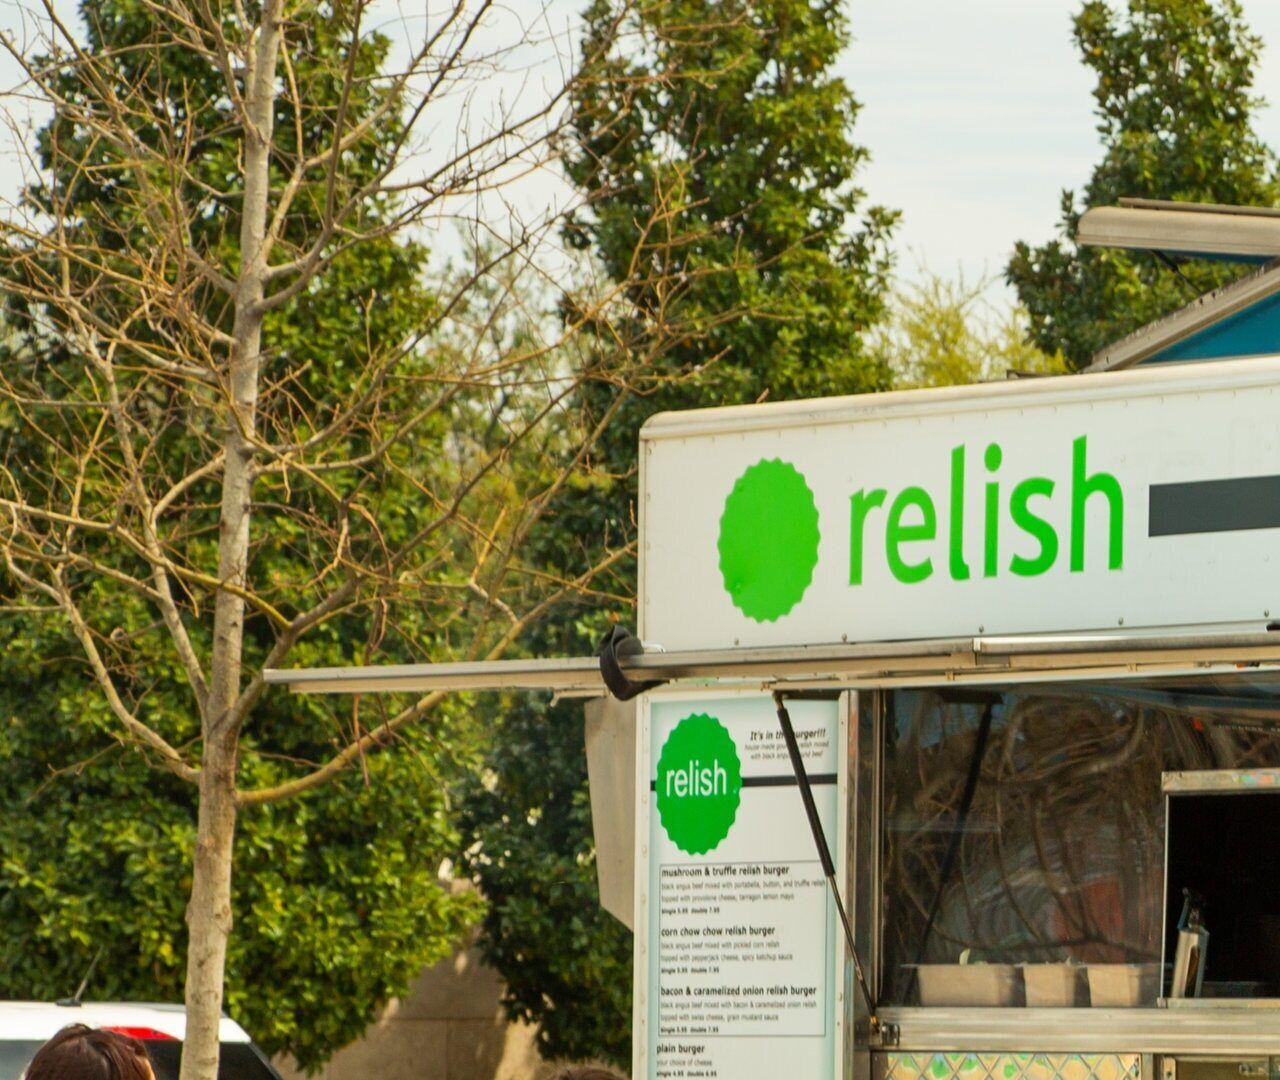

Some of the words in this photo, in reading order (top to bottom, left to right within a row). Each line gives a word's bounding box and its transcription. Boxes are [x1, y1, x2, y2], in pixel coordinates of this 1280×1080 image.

[848, 434, 1124, 586] relish
[750, 731, 763, 740] It's
[766, 730, 773, 739] in
[795, 727, 826, 741] urger!!!
[666, 759, 727, 796] relish
[660, 867, 702, 876] mushroom
[704, 866, 710, 875] &
[712, 866, 736, 875] truffle
[738, 866, 761, 875] relish
[762, 865, 789, 877] burger
[680, 928, 700, 936] chow
[702, 927, 722, 935] chow
[724, 927, 746, 935] relish
[748, 926, 774, 936] burger
[660, 987, 683, 995] bacon
[685, 987, 691, 995] &
[693, 987, 740, 995] caramelized
[742, 986, 764, 995] onion
[766, 986, 788, 995] relish
[790, 986, 816, 997] burger
[656, 1044, 676, 1055] plain
[678, 1045, 704, 1055] burger
